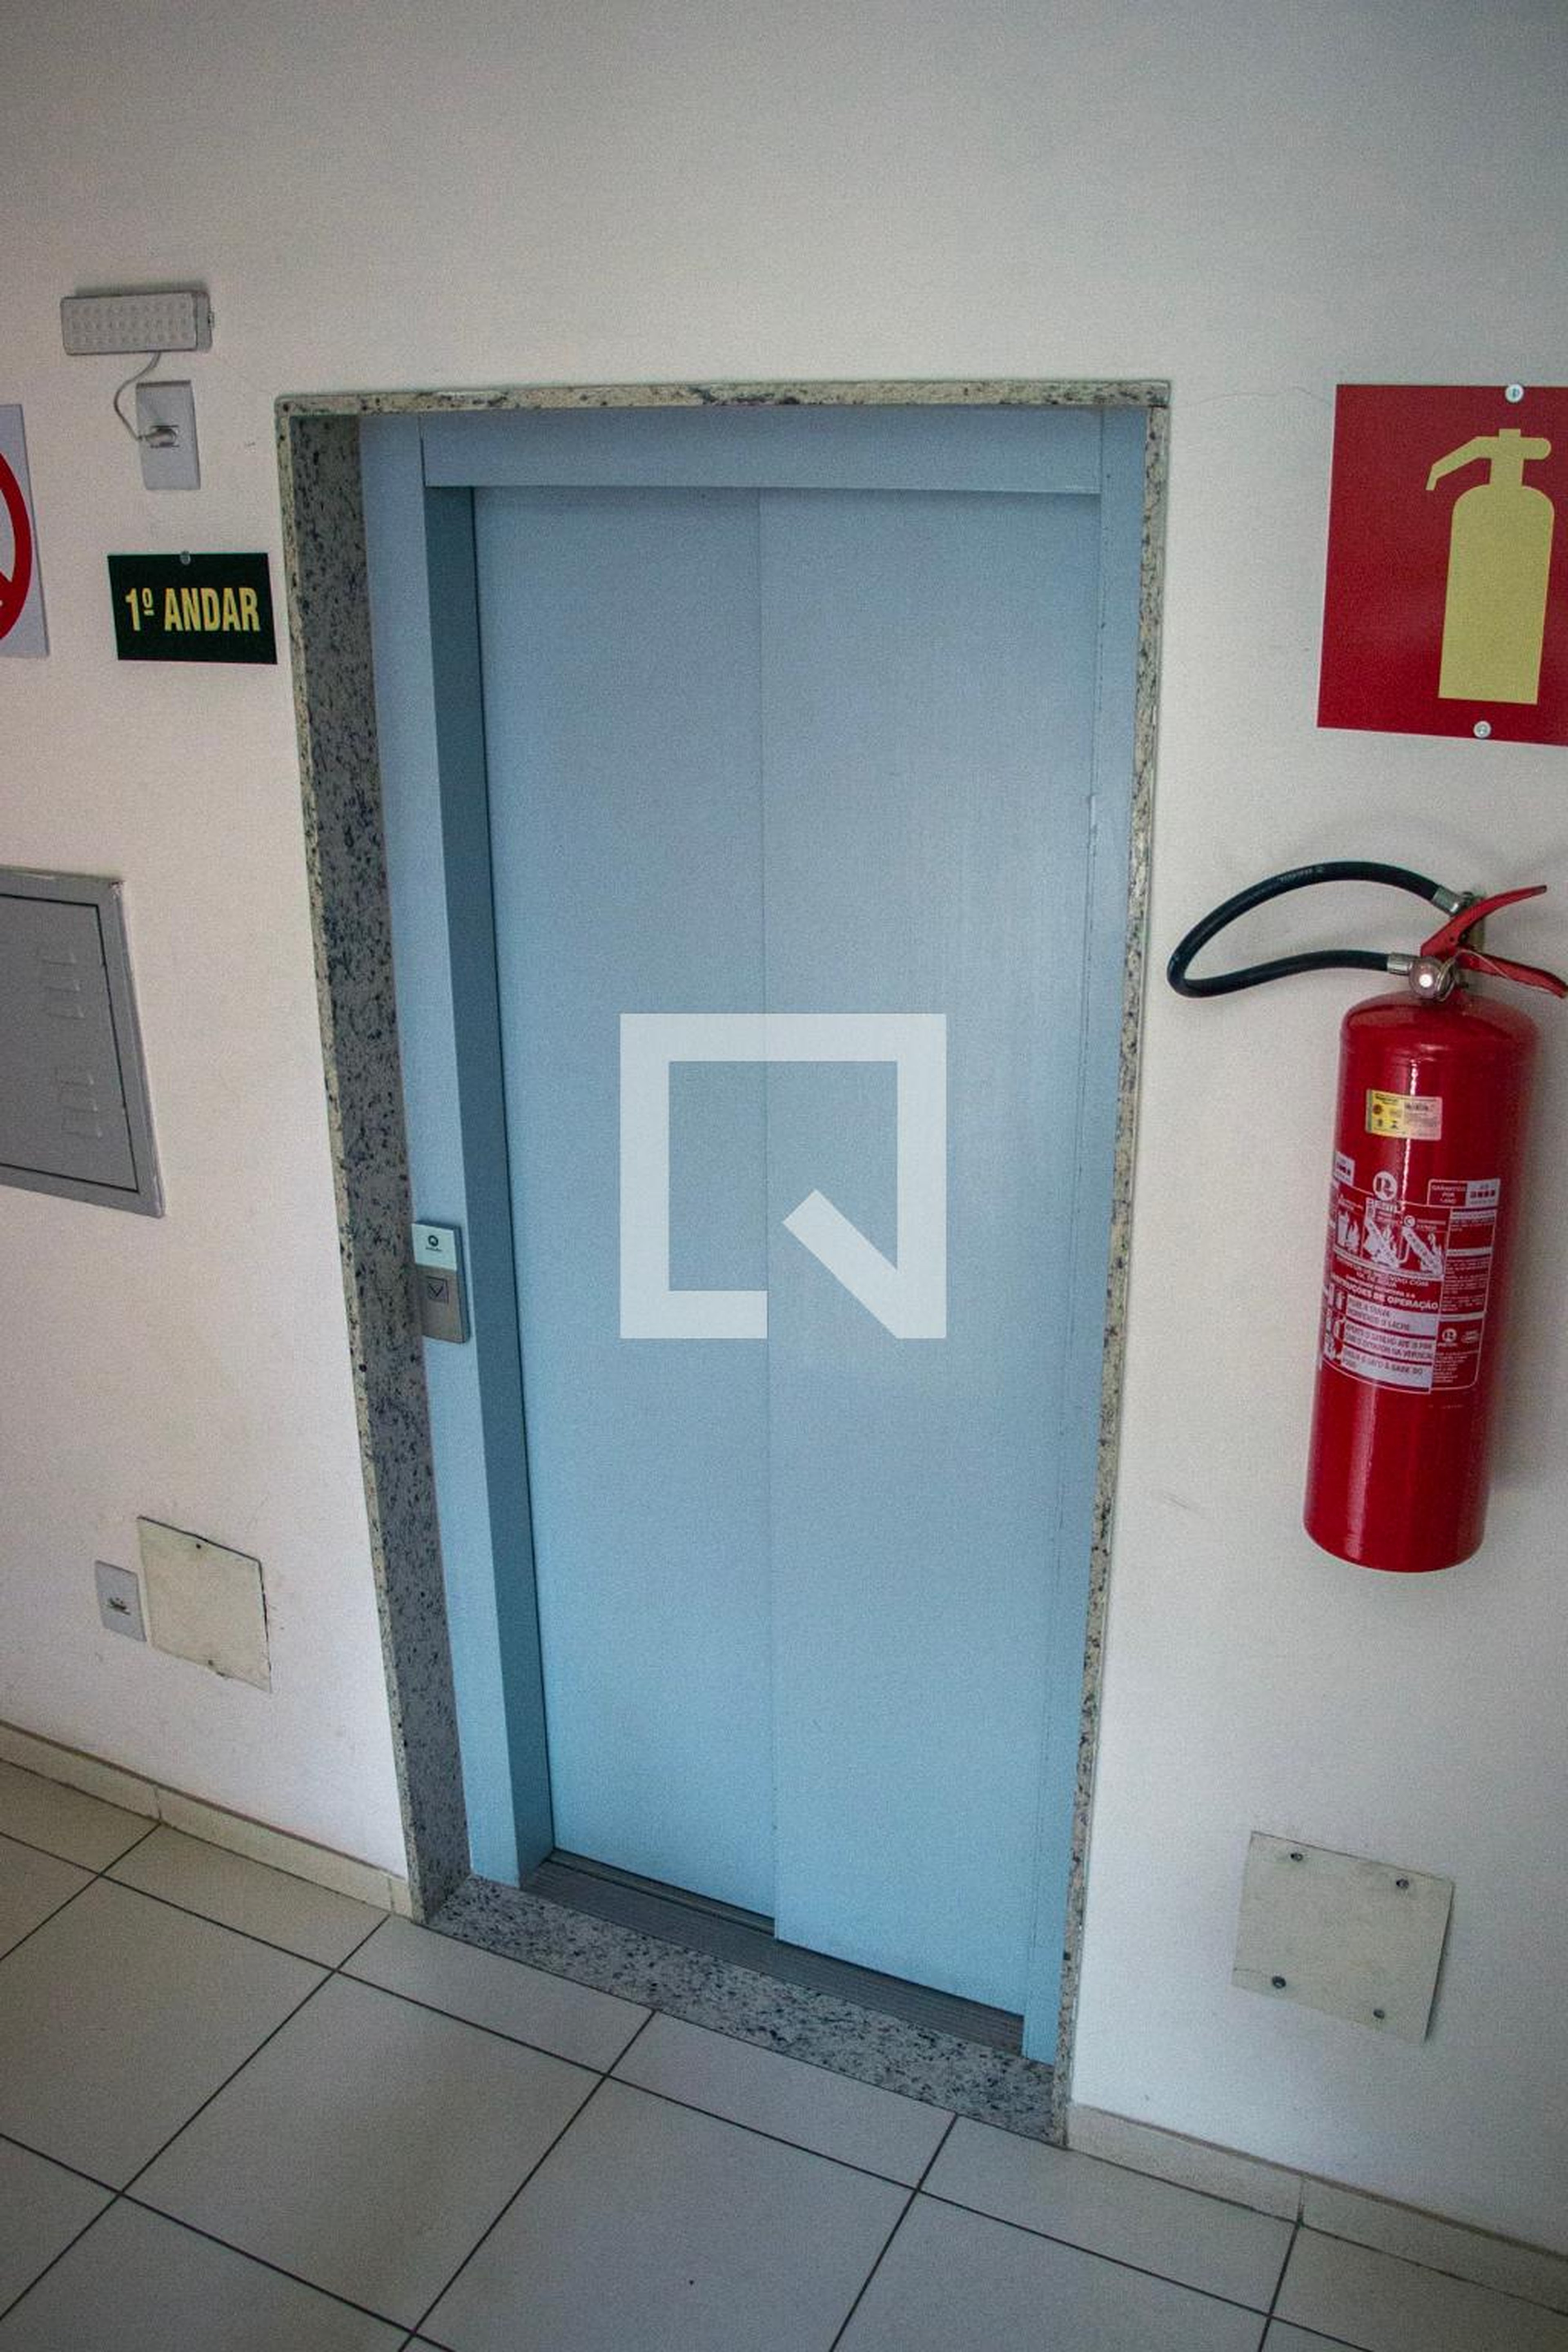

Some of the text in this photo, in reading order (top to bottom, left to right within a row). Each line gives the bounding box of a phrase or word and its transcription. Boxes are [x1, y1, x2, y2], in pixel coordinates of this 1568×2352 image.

[125, 587, 261, 632] 1º ANDAR
[1331, 1272, 1372, 1299] STRUÇÕES
[1387, 1295, 1438, 1311] OPERAÇÃO
